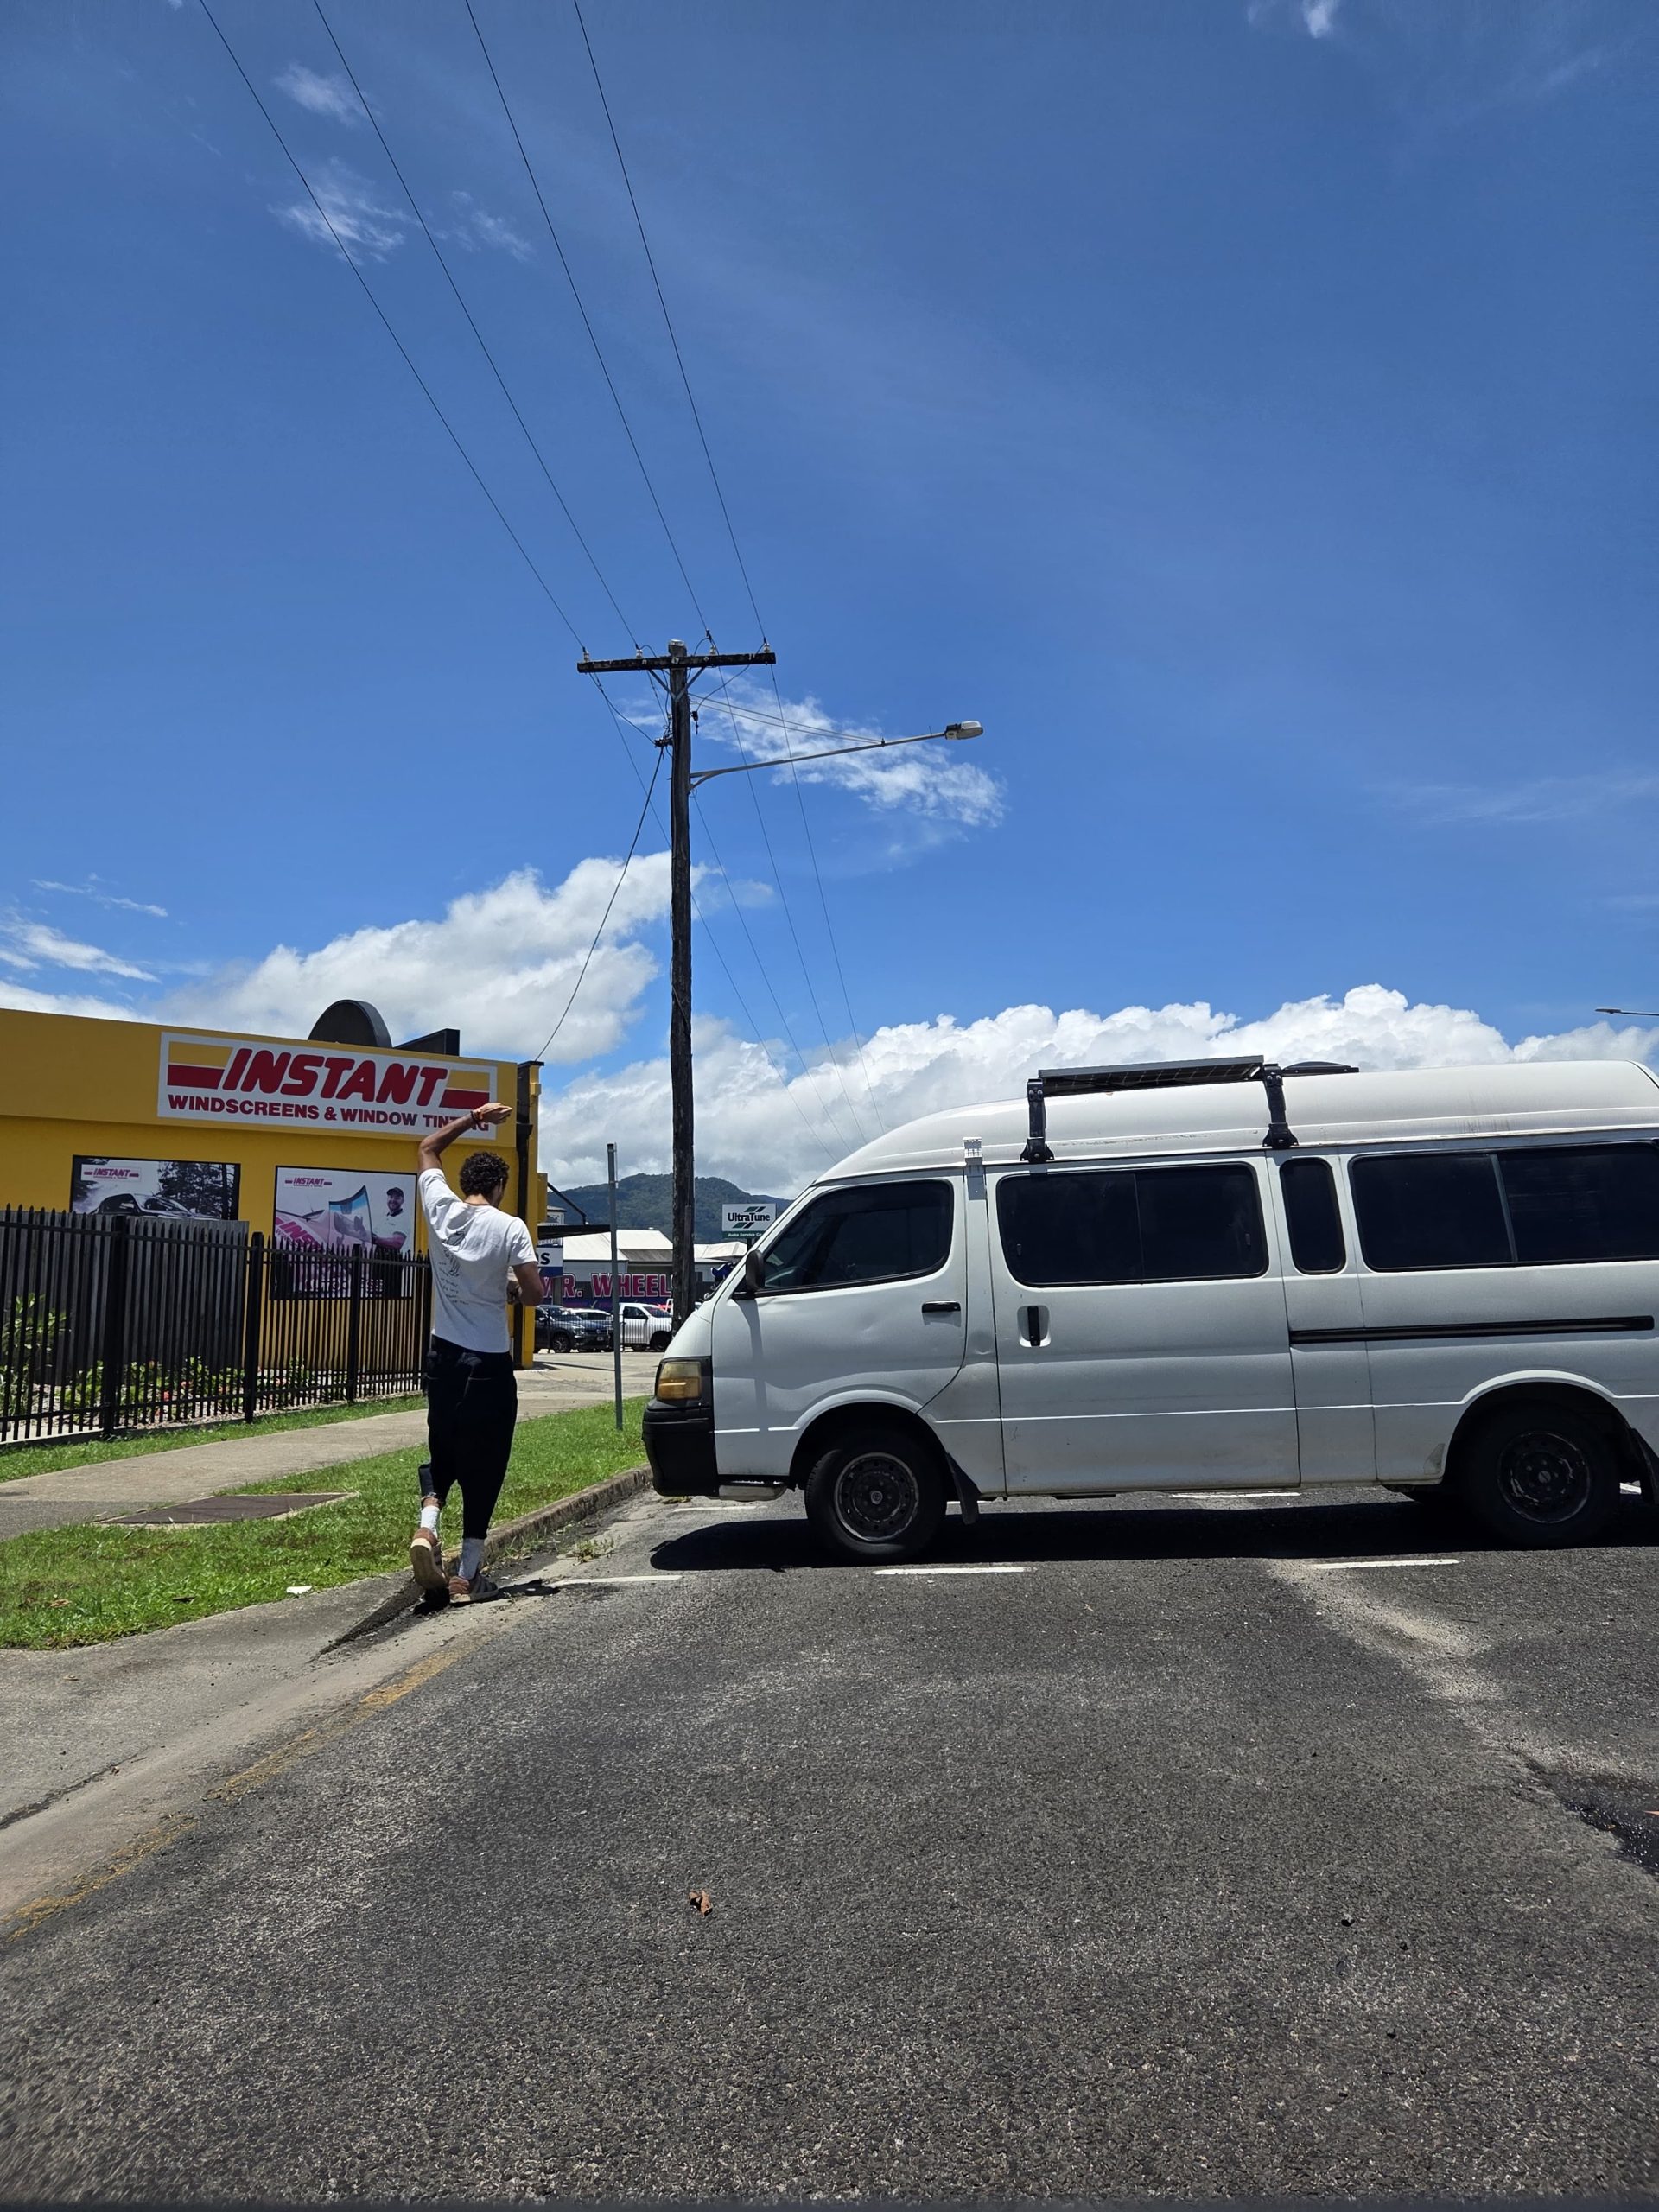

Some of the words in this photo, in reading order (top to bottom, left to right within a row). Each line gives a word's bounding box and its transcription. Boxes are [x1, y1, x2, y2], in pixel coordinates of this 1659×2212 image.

[222, 1048, 448, 1106] INSTANT
[168, 1094, 320, 1120] WINDSCREENS
[324, 1106, 337, 1121] &
[340, 1108, 418, 1126] WINDOW
[93, 1168, 130, 1177] INSTANT
[294, 1177, 325, 1185] INSTANT
[728, 1212, 771, 1222] UltraTune
[591, 1273, 673, 1298] WHEEL
